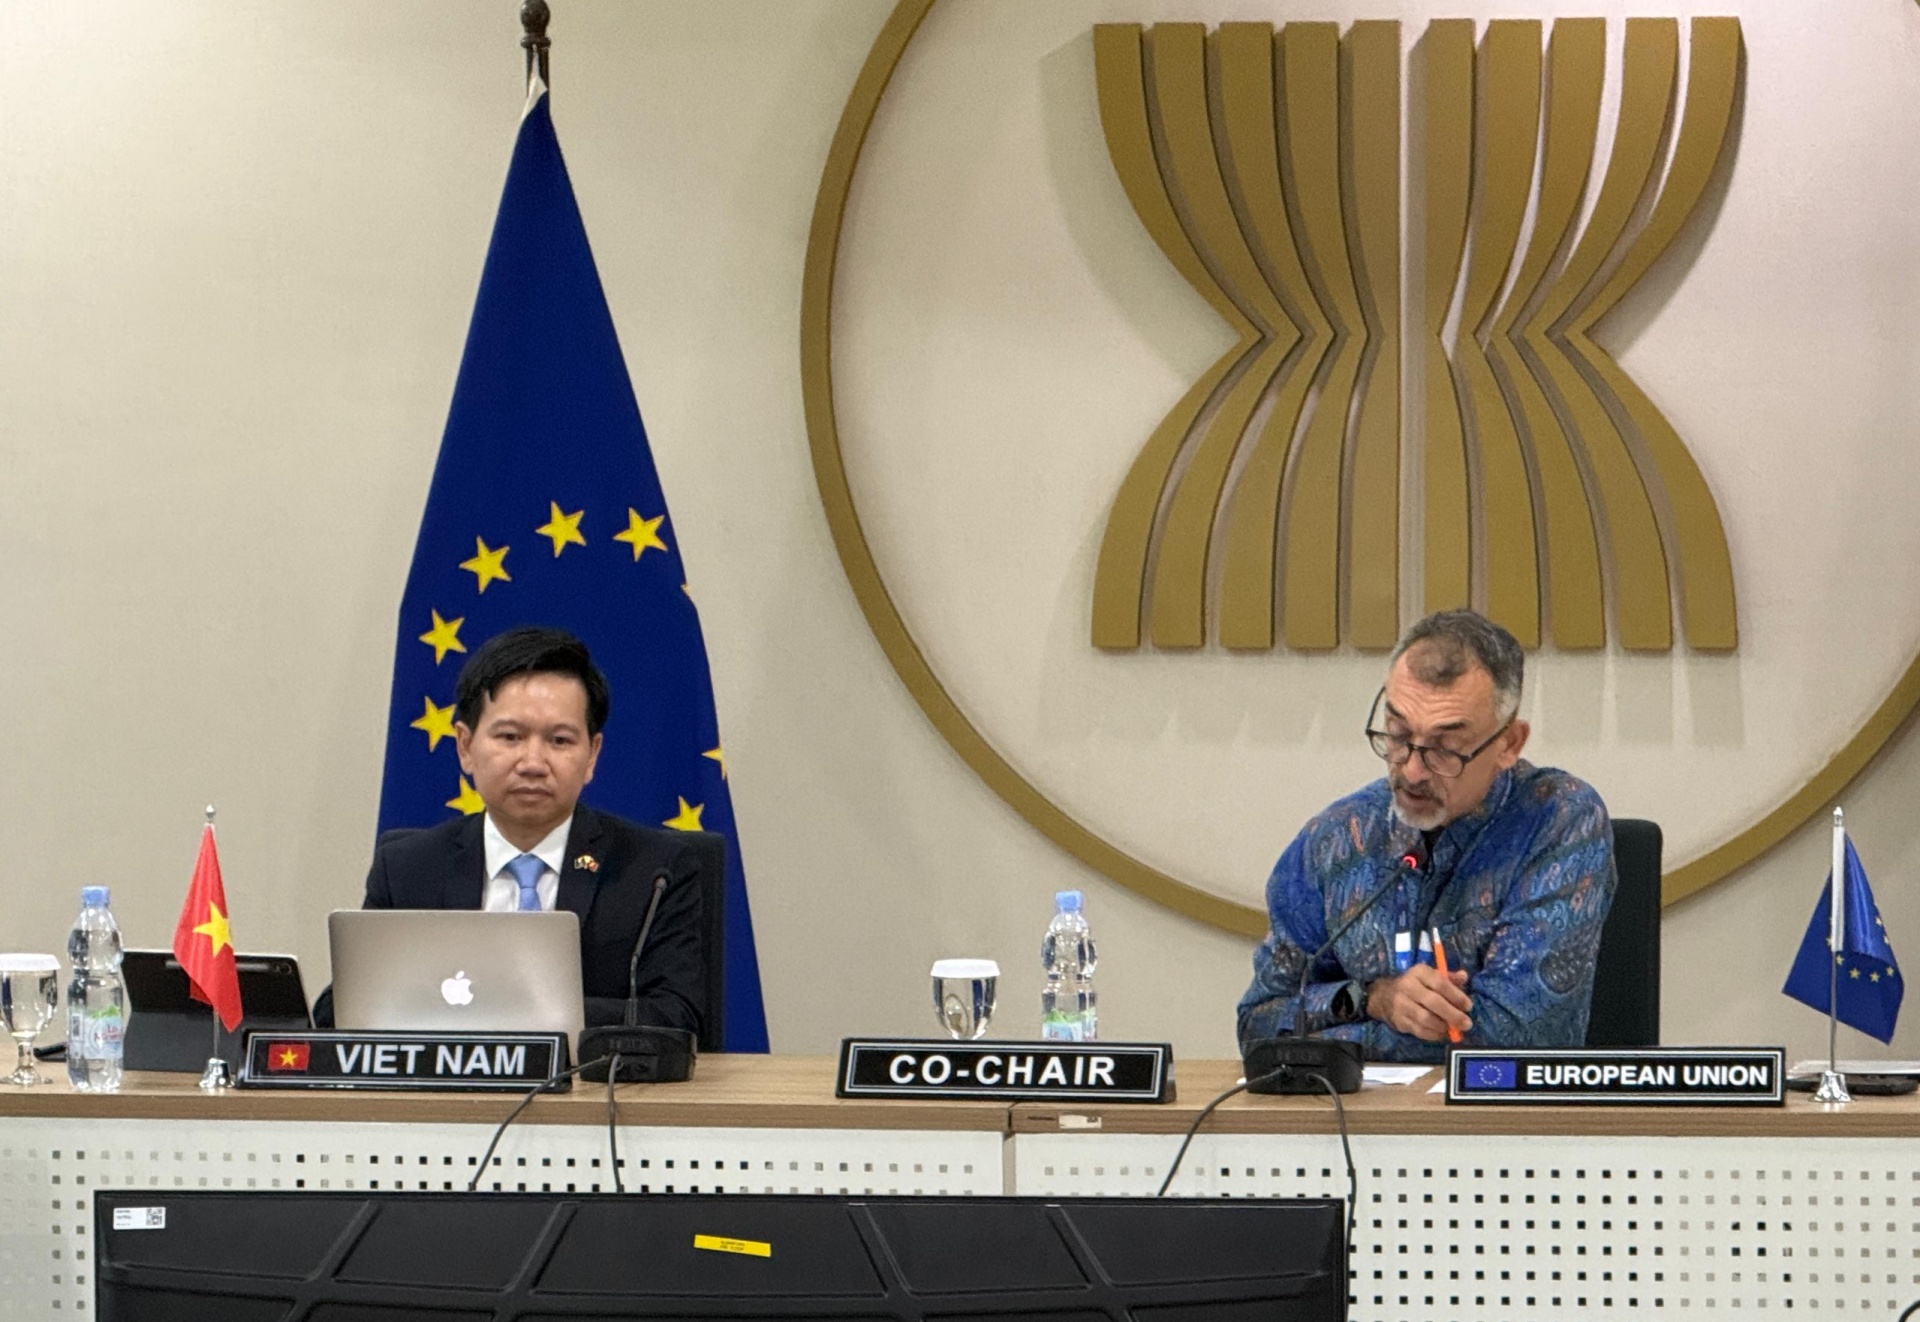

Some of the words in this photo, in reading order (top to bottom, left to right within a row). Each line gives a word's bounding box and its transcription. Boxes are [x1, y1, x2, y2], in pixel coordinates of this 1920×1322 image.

[335, 1044, 426, 1074] VIET
[435, 1044, 526, 1075] NAM
[888, 1054, 1115, 1086] CO-CHAIR
[1526, 1064, 1676, 1086] EUROPEAN
[1683, 1065, 1768, 1086] UNION
